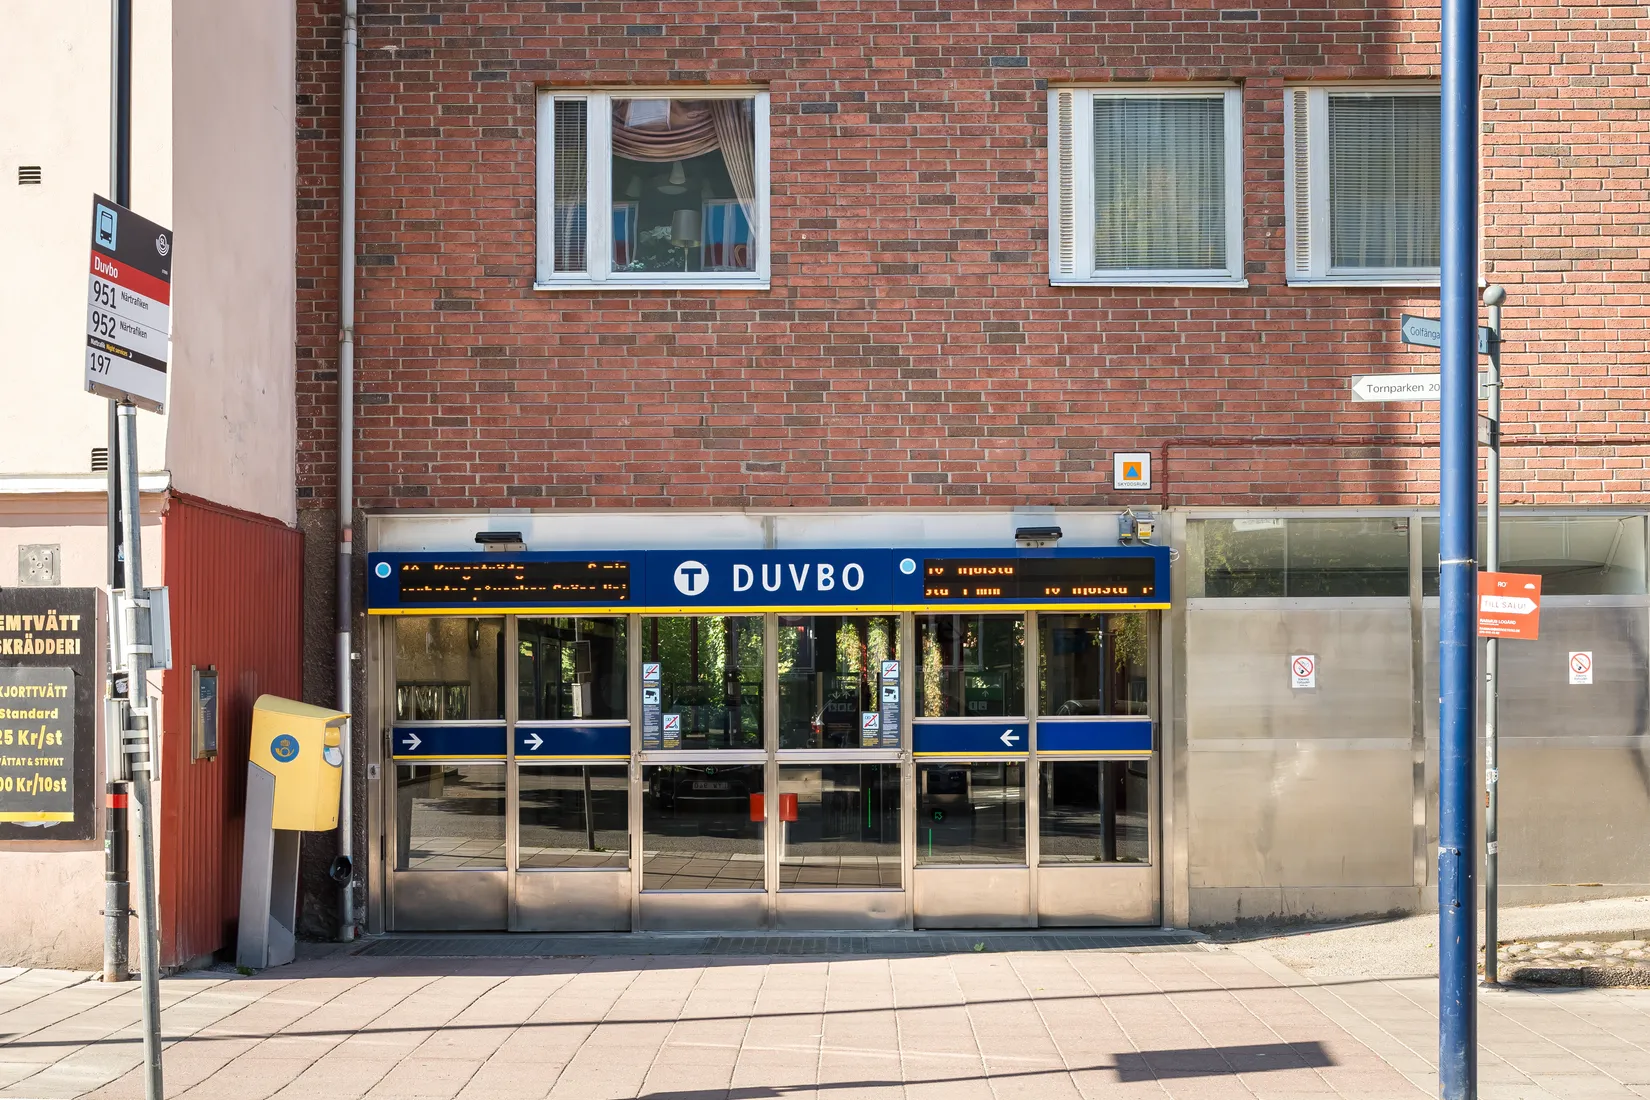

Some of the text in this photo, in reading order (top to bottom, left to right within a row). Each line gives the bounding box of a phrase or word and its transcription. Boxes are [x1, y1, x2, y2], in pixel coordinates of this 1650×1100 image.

[94, 256, 119, 278] Duvbo
[93, 280, 149, 310] 951 Närtrafiken
[92, 310, 148, 339] 952 Närtrafiken
[90, 352, 111, 375] 197
[1366, 383, 1424, 394] Tornparken
[733, 563, 865, 592] DUVBO
[1484, 600, 1499, 608] TILL
[0, 633, 81, 655] KRÄDDERI
[0, 707, 59, 719] Standard
[0, 725, 63, 750] 5 Kr/st
[0, 755, 65, 766] ÄTTAT & STRYKT
[16, 773, 67, 796] Kr/10st
